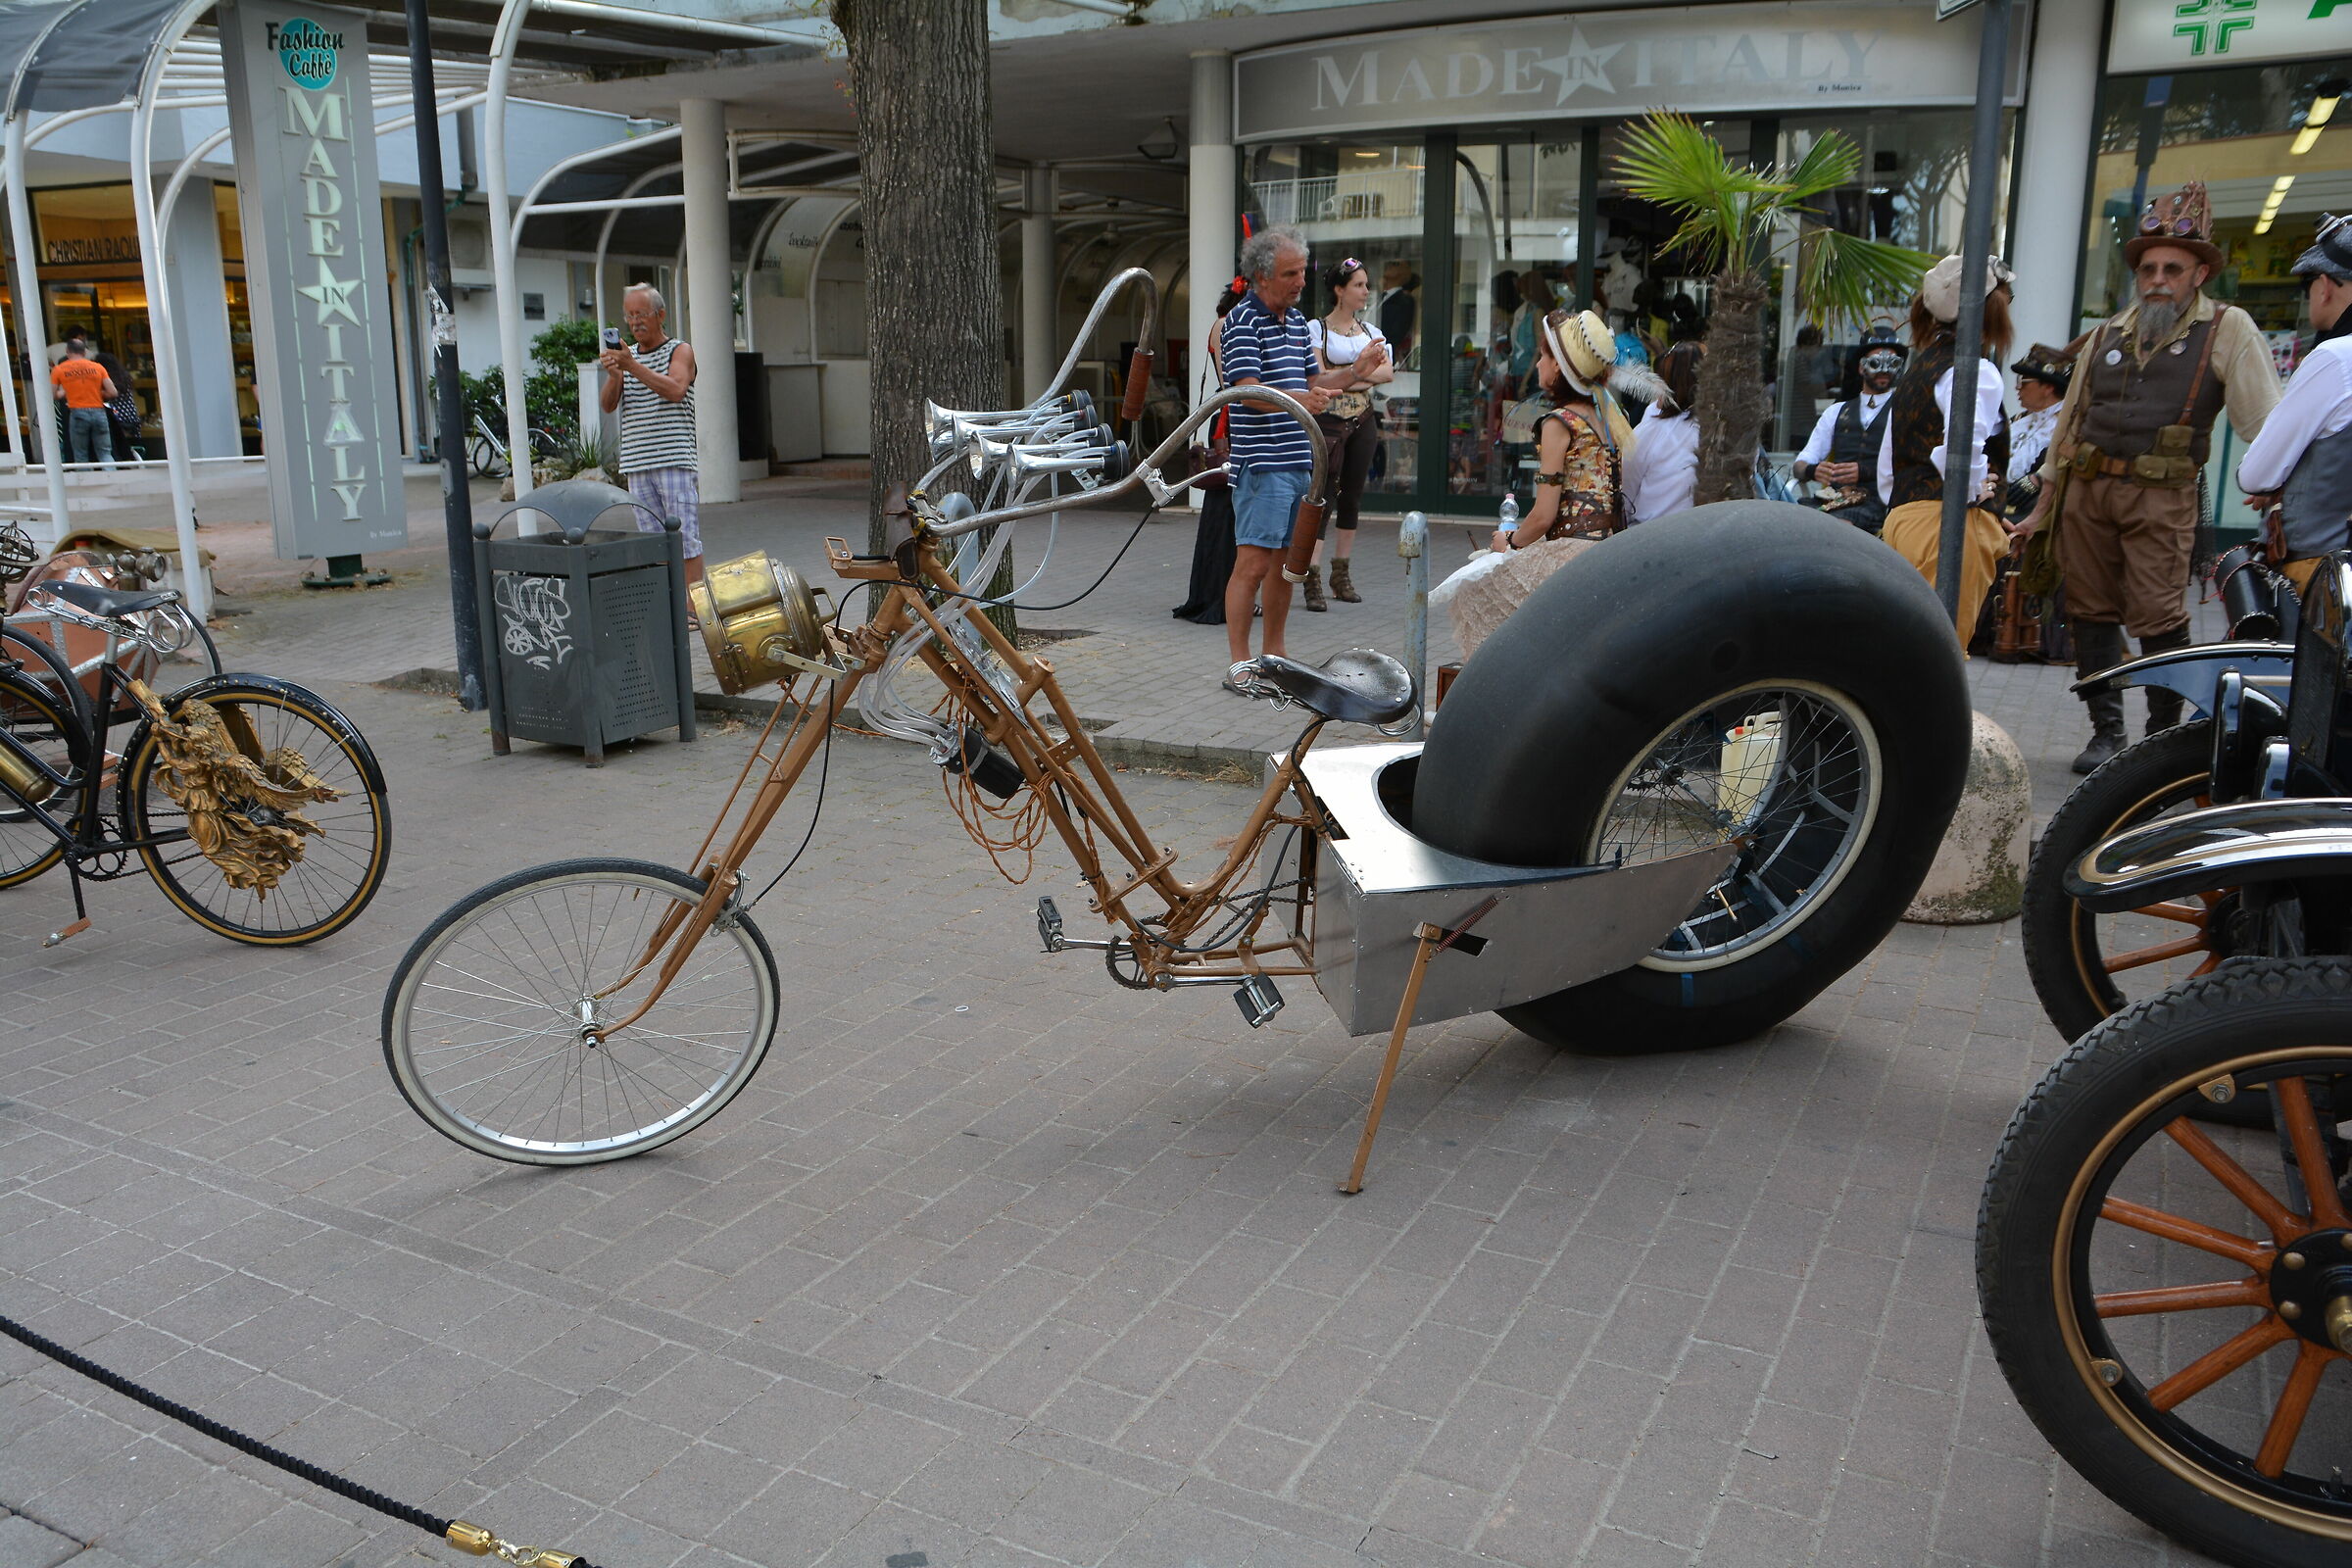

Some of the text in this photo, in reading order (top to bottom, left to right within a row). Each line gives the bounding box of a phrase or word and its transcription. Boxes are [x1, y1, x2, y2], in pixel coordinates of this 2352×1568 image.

[266, 22, 344, 50] Fashion
[289, 52, 332, 78] Caffè
[1310, 28, 1885, 111] MADE IN ITALY
[48, 236, 103, 264] CHRISTIAN
[278, 86, 368, 521] MADE IN ITALY
